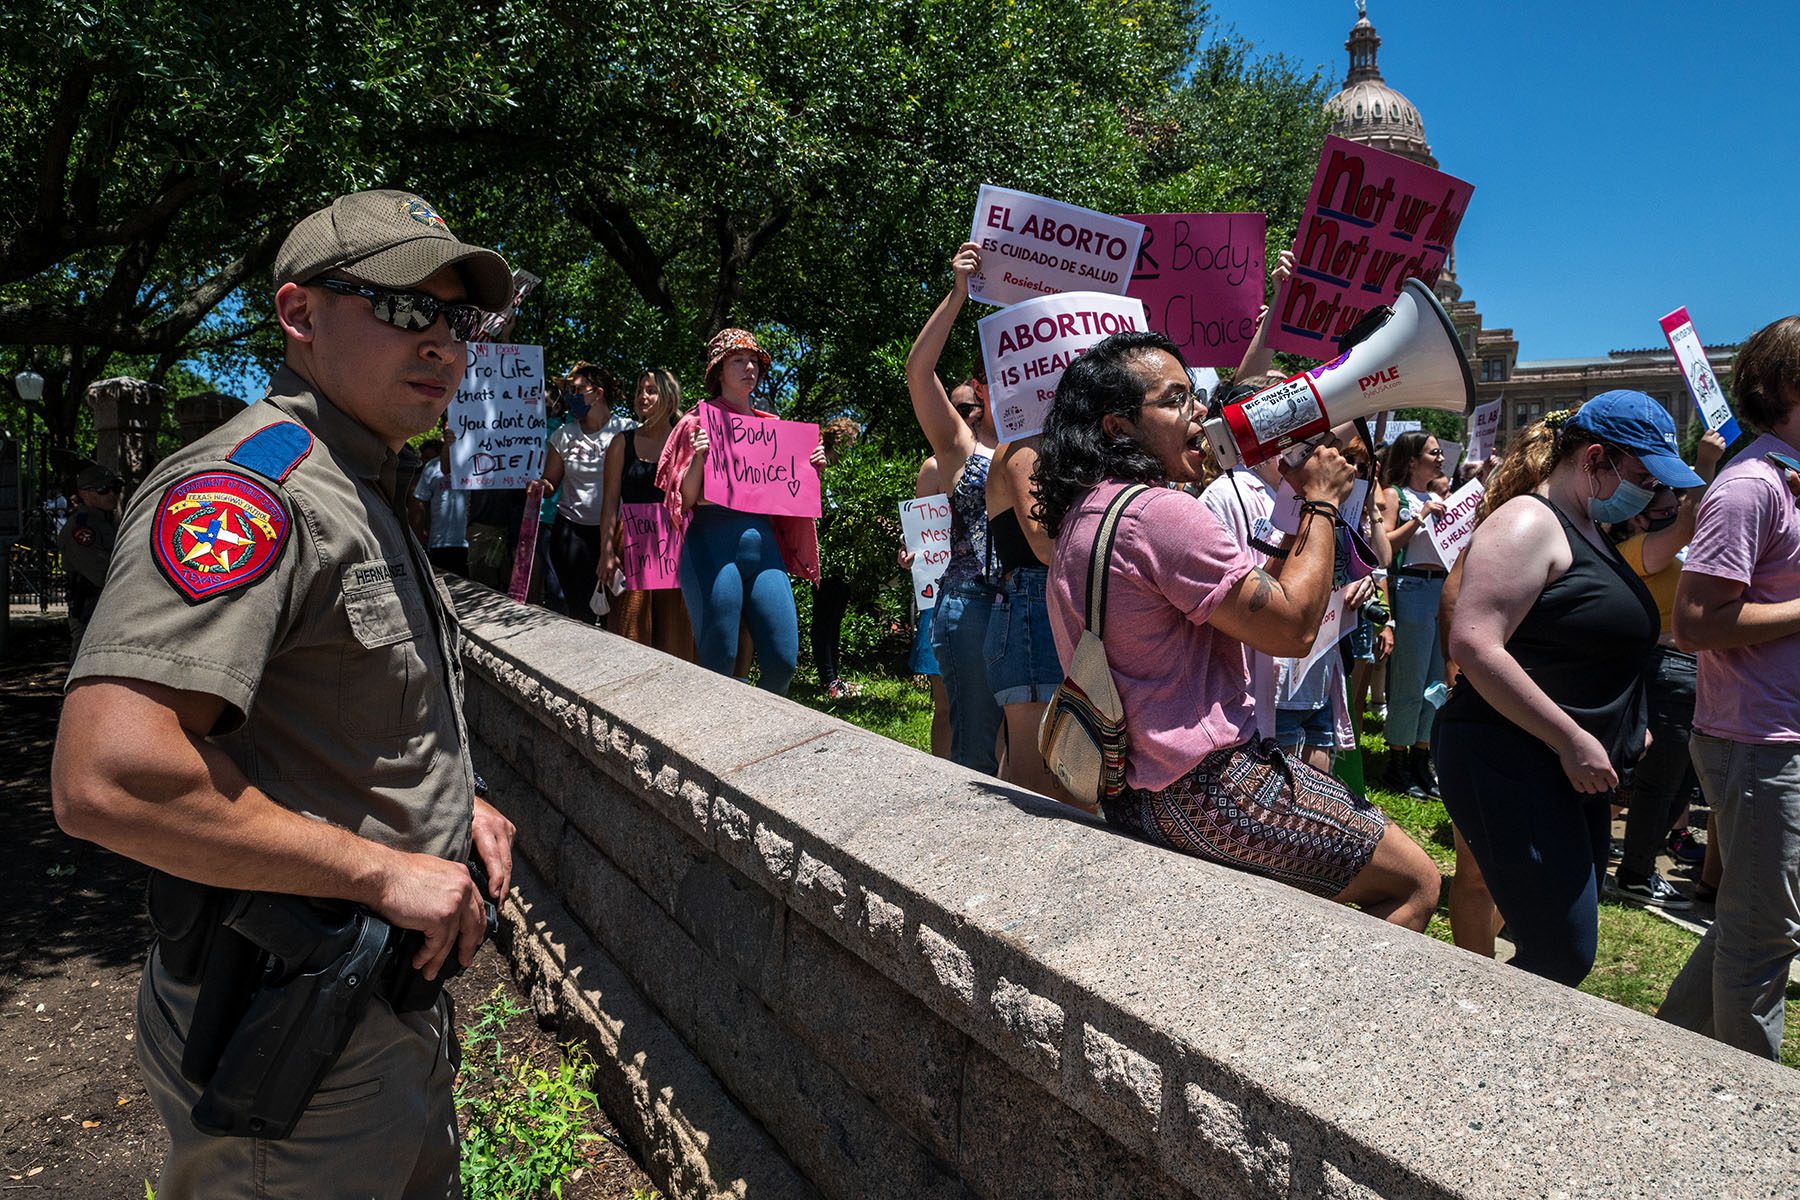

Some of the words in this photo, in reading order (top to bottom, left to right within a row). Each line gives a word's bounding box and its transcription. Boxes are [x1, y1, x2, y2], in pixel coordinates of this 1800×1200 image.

[987, 204, 1014, 233] EL
[1019, 214, 1127, 261] ABORTO
[1394, 194, 1436, 235] ur
[982, 238, 999, 252] ES
[1000, 243, 1059, 269] CUIDADO
[1060, 258, 1078, 274] DE
[1078, 264, 1119, 285] SALUD
[1137, 225, 1159, 271] R
[997, 311, 1136, 359] ABORTION
[1001, 365, 1020, 388] IS
[1024, 349, 1090, 381] HEAL
[502, 390, 513, 400] a
[1244, 399, 1261, 410] BIG
[731, 417, 778, 461] Body
[177, 479, 225, 497] DEPARTMENT
[226, 480, 238, 489] OF
[237, 484, 262, 503] PUBLIC
[260, 497, 282, 523] SAFETY
[187, 493, 213, 502] TEXAS
[213, 494, 245, 507] HIGHWAY
[243, 502, 269, 521] PATROL
[1433, 490, 1483, 537] ABORTION
[920, 527, 952, 544] Mes
[1440, 539, 1450, 551] IS
[180, 568, 222, 586] TEXAS
